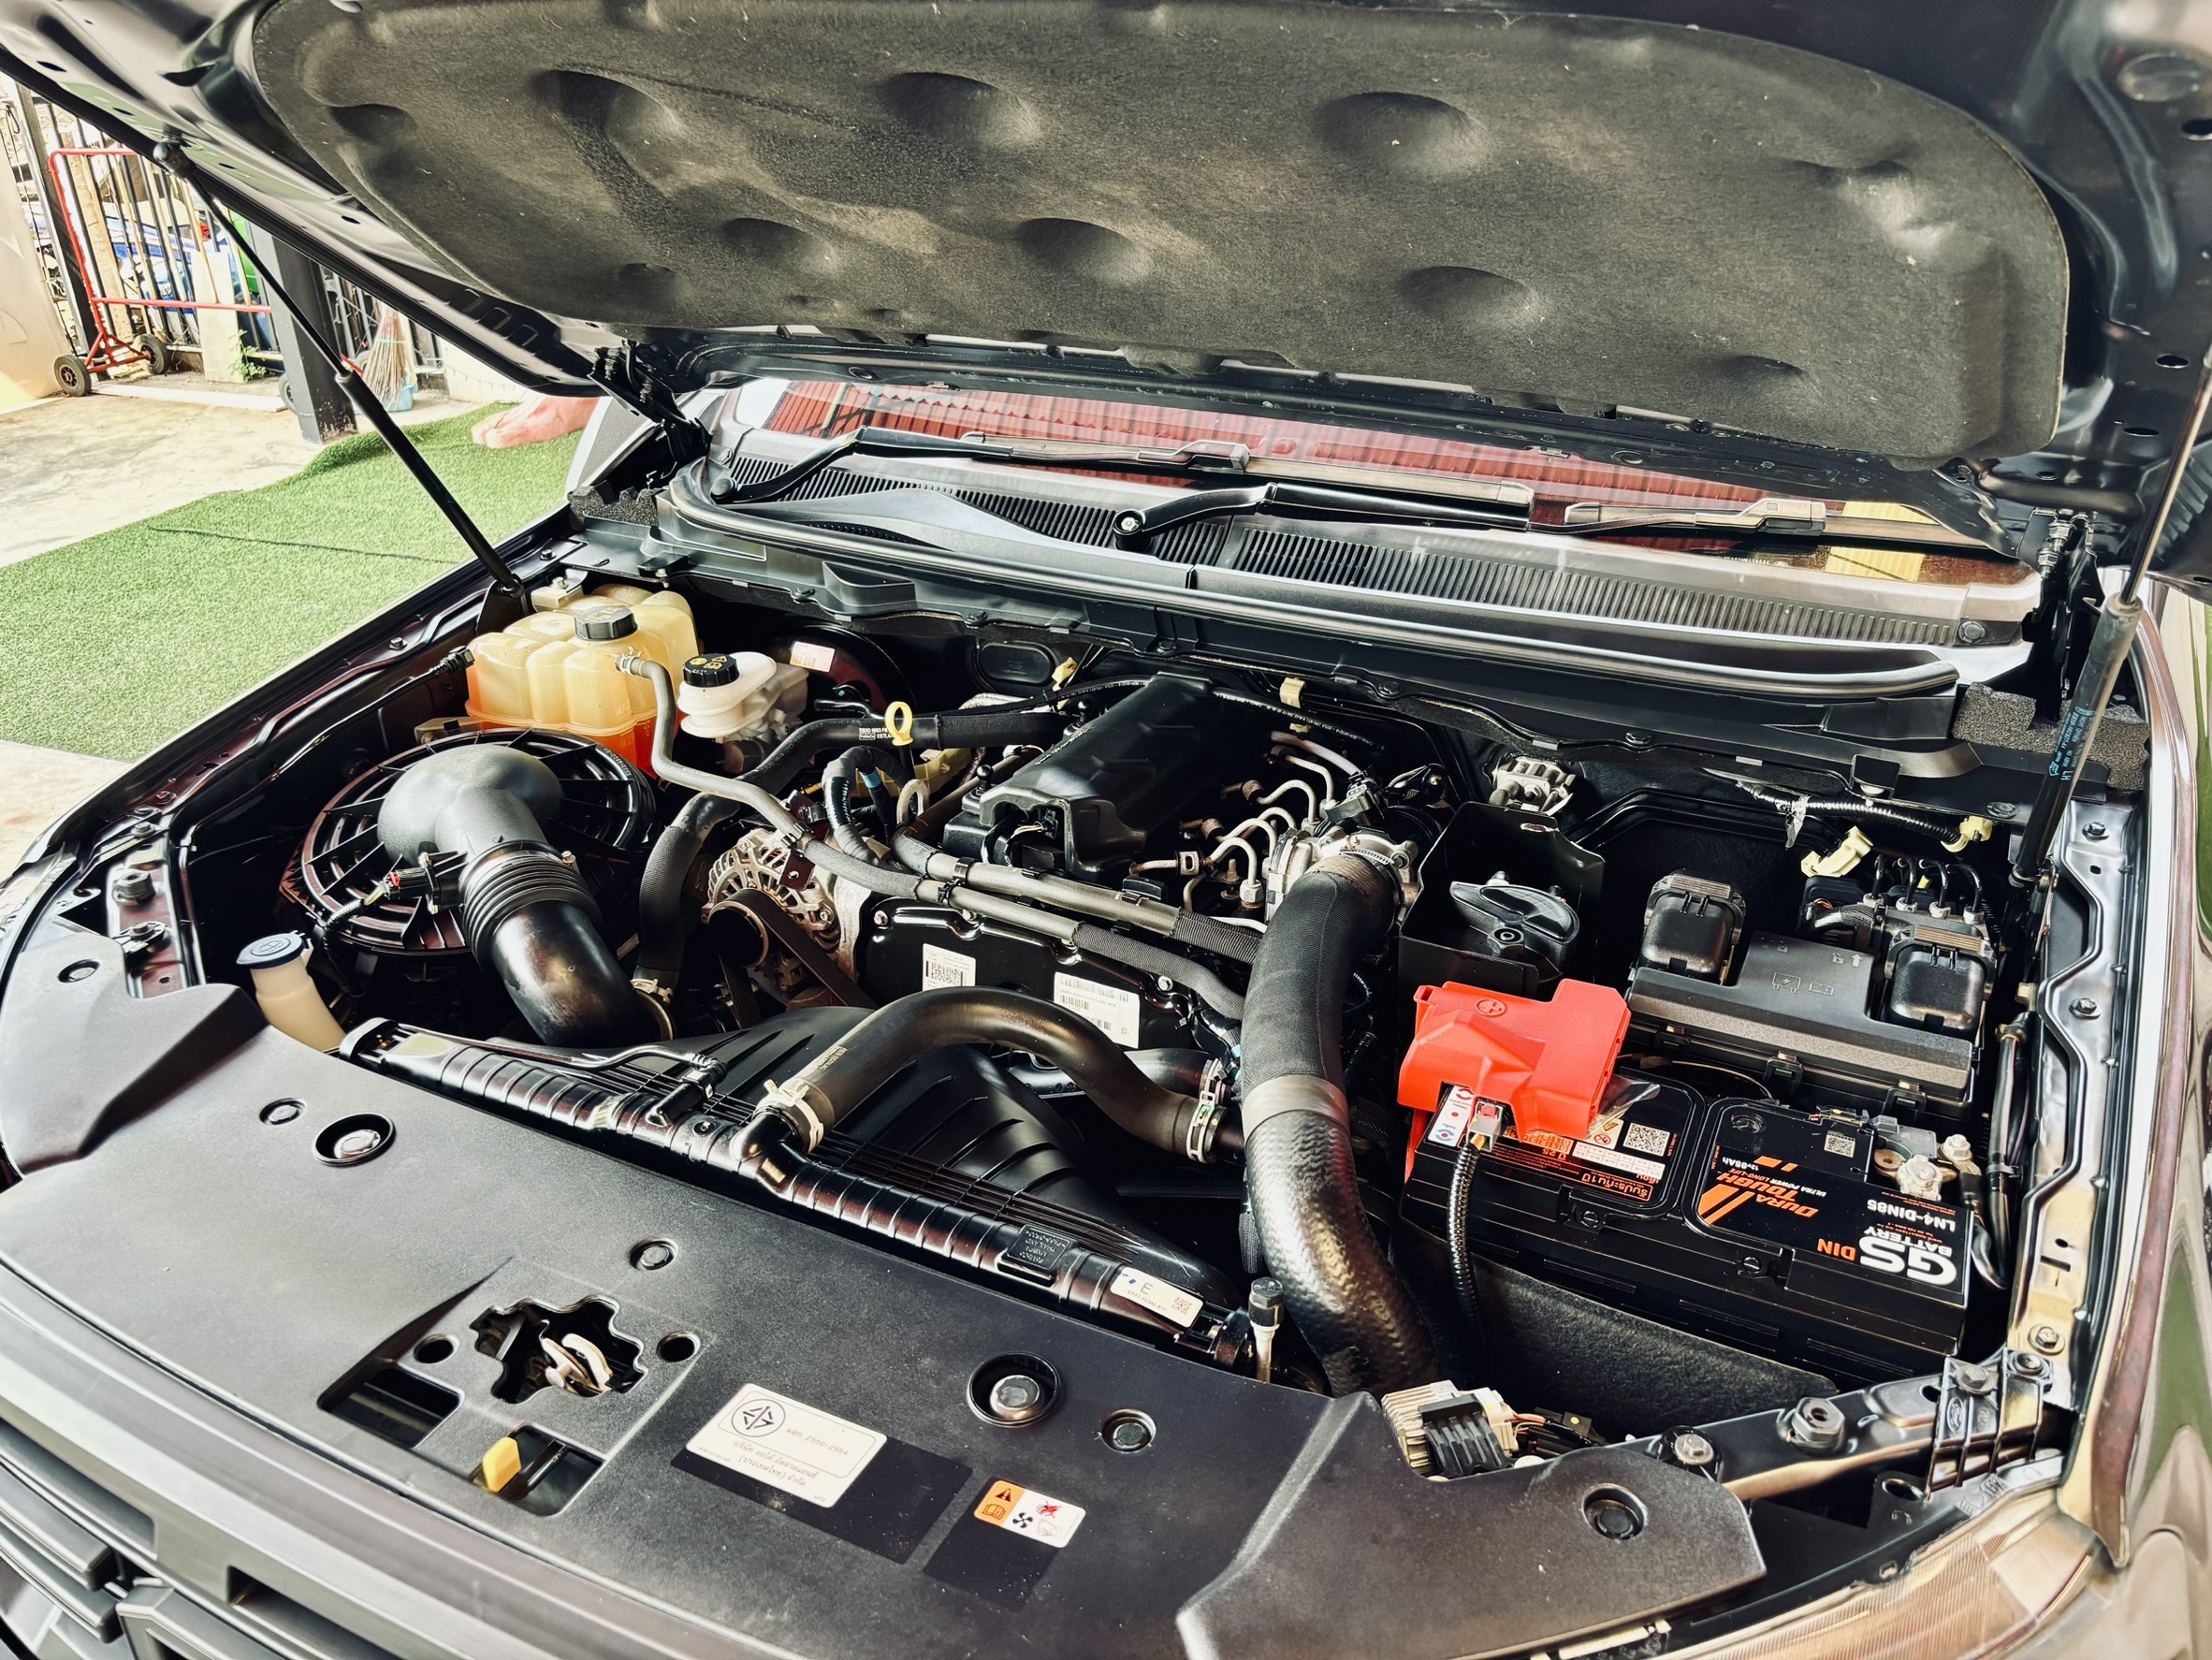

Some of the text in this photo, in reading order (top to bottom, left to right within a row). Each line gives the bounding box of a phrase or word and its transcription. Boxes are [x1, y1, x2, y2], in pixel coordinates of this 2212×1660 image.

[2059, 770, 2074, 780] LH
[1542, 1147, 1556, 1157] 25
[1716, 1172, 1798, 1201] TOUGH
[1728, 1168, 1826, 1198] ULTRA POWER LONG-LIFE
[1755, 1193, 1819, 1218] DURA
[1867, 1199, 1956, 1232] LN4-DIN85
[1863, 1226, 1953, 1258] BATTERY
[1816, 1235, 1957, 1286] GS DIN
[1140, 1282, 1153, 1295] E
[805, 1434, 850, 1456] 2550-2554
